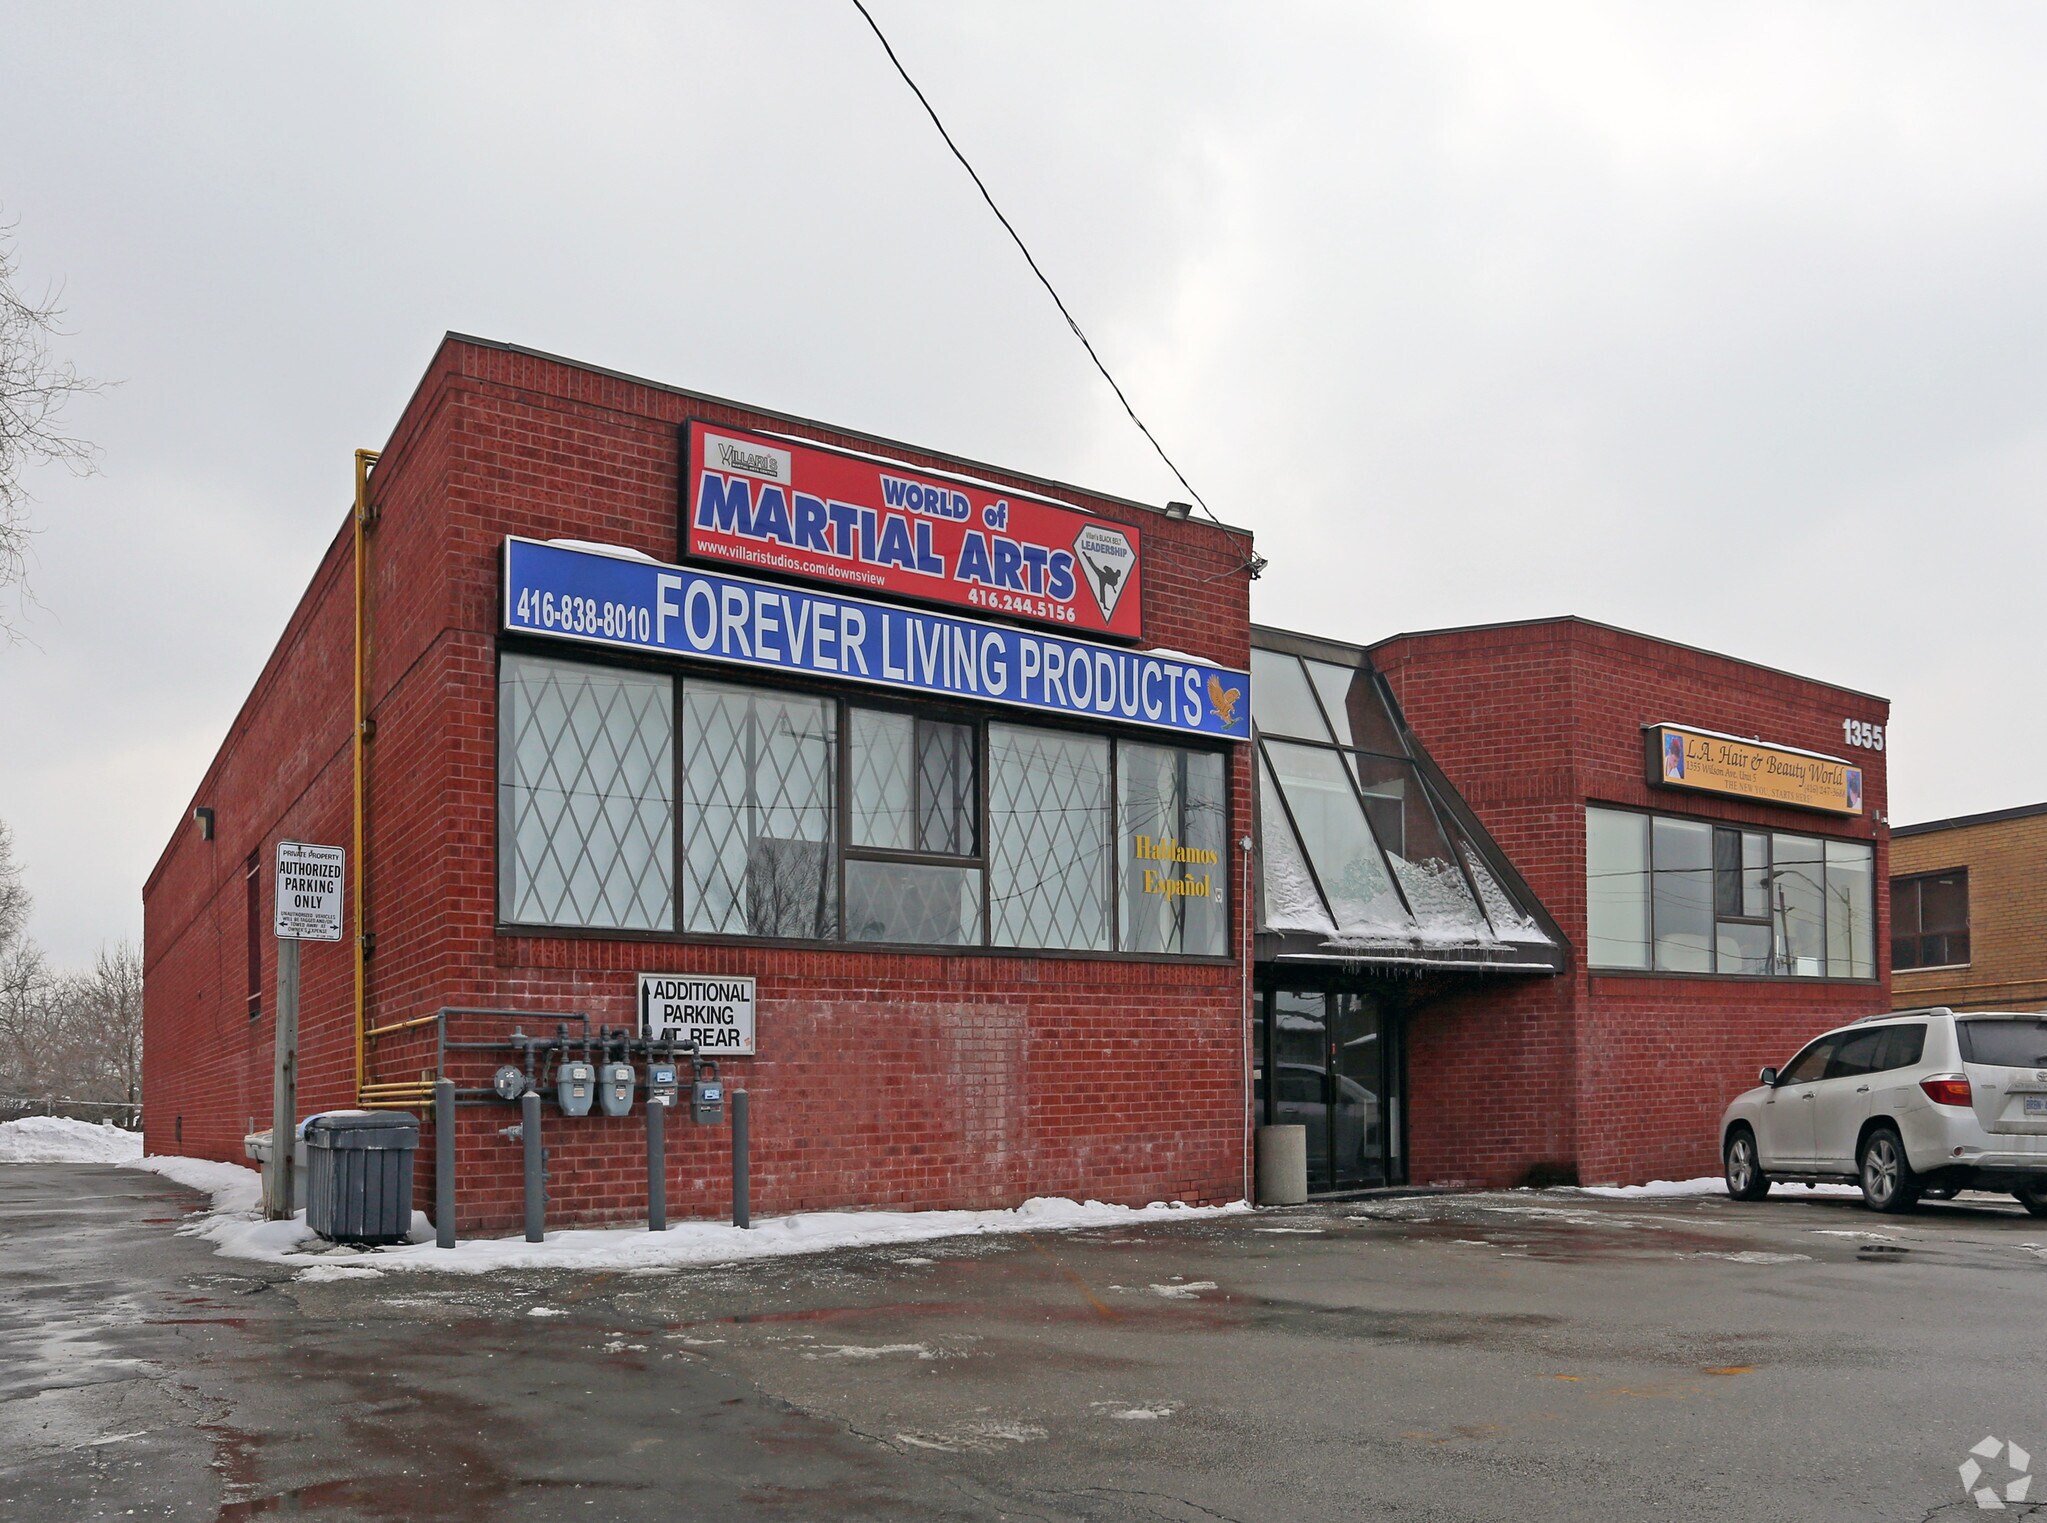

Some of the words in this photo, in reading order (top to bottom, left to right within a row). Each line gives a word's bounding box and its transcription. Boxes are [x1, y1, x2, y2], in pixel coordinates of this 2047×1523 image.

[880, 475, 971, 523] WORLD
[982, 501, 1008, 531] of
[694, 470, 945, 578] MARTIAL
[954, 529, 1076, 603] ARTS
[1081, 540, 1128, 558] LEADERSHIP
[697, 540, 885, 586] www.villaristudios.com/downsview
[516, 587, 650, 642] 416-838-8010
[968, 588, 1076, 623] 416.244.5156
[657, 573, 869, 675] FOREVER
[882, 614, 1007, 696] LIVING
[1020, 638, 1202, 727] PRODUCTS
[1842, 718, 1884, 751] 1355
[1686, 739, 1714, 762] L.A.
[1719, 744, 1748, 768] Hair
[1751, 753, 1763, 771] &
[1766, 755, 1806, 788] Beauty
[1808, 763, 1845, 786] World
[1702, 763, 1724, 776] Wilson
[1724, 779, 1738, 791] THE
[283, 850, 306, 858] PRIVATE
[308, 851, 340, 861] PROPERTY
[1135, 834, 1218, 865] Hablamos
[279, 861, 341, 878] AUTHORIZED
[285, 877, 334, 894] PARKING
[1144, 869, 1210, 904] Español
[294, 894, 322, 909] ONLY
[653, 980, 750, 1003] ADDITIONAL
[663, 1004, 734, 1025] PARKING
[690, 1028, 740, 1047] REAR
